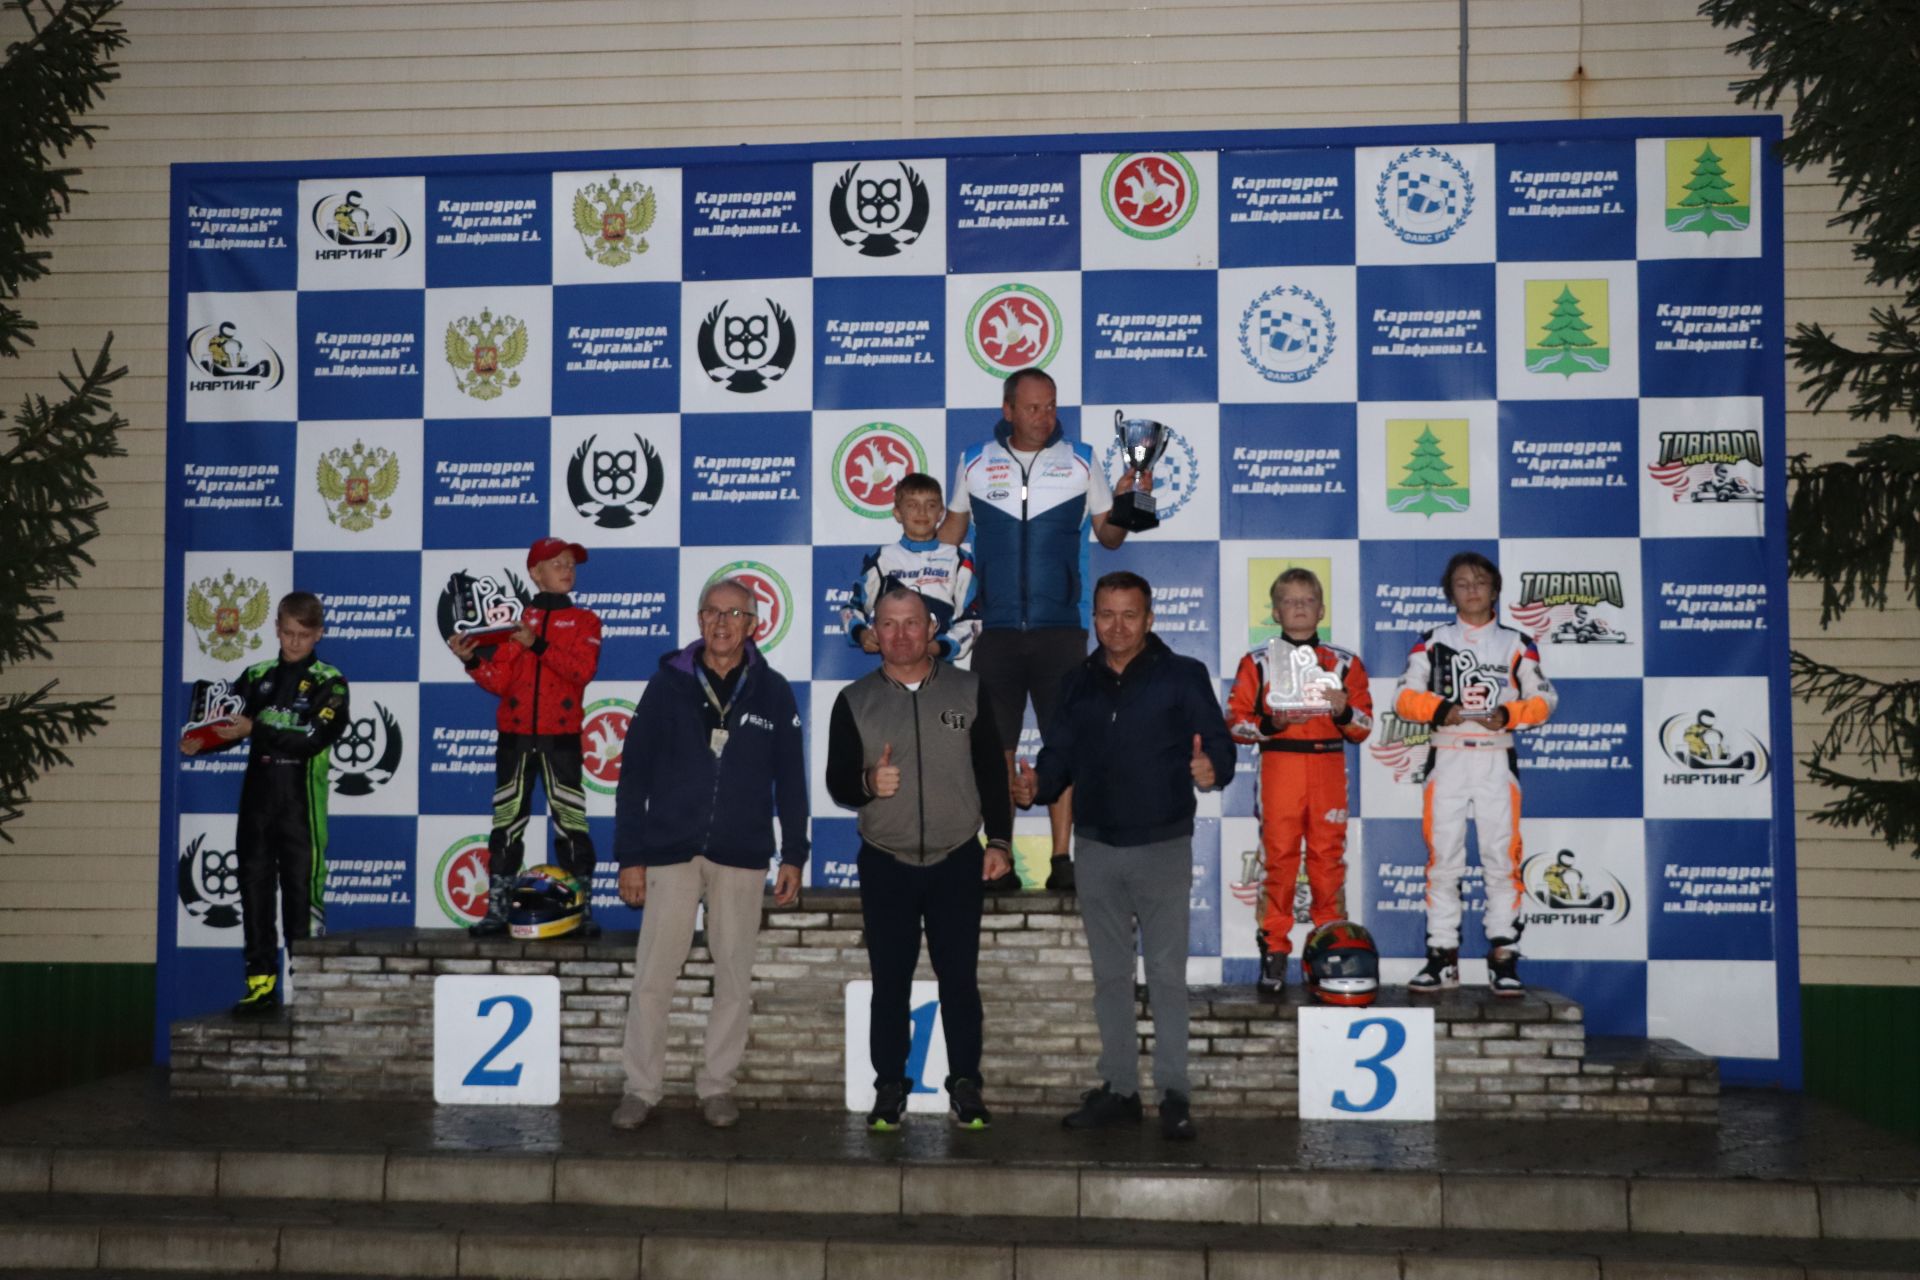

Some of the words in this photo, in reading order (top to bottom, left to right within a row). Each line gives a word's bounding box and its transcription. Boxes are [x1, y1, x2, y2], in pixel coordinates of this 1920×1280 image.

[1231, 176, 1338, 193] Картодром
[1509, 170, 1618, 187] Картодром
[694, 191, 796, 206] Картодром
[959, 182, 1064, 199] Картодром
[1236, 190, 1334, 207] "Аргамак"
[1514, 185, 1614, 202] "Аргамак"
[437, 199, 536, 214] Картодром
[964, 196, 1060, 213] "Аргамак"
[1602, 202, 1624, 213] Е.А.
[188, 206, 282, 220] Картодром
[699, 204, 792, 222] "Аргамак"
[1048, 214, 1069, 226] Е.А.
[1322, 208, 1343, 220] Е.А.
[191, 219, 278, 235] "Аргамак"
[442, 213, 532, 230] "Аргамак"
[780, 222, 801, 233] Е.А.
[267, 236, 287, 248] Е.А.
[521, 230, 541, 242] Е.А.
[1096, 313, 1202, 330] Картодром
[1373, 309, 1481, 326] Картодром
[567, 326, 667, 341] Картодром
[826, 319, 930, 335] Картодром
[1377, 324, 1477, 341] "Аргамак"
[1661, 319, 1761, 336] "Аргамак"
[315, 332, 414, 346] Картодром
[830, 334, 925, 351] "Аргамак"
[1101, 328, 1198, 344] "Аргамак"
[319, 346, 410, 362] "Аргамак"
[572, 339, 663, 356] "Аргамак"
[1186, 346, 1207, 357] Е.А.
[1465, 341, 1487, 354] Е.А.
[652, 357, 672, 369] Е.А.
[913, 351, 934, 363] Е.А.
[399, 363, 418, 375] Е.А.
[1233, 447, 1340, 464] Картодром
[1511, 440, 1622, 457] Картодром
[1659, 430, 1762, 467] TORNADO
[184, 463, 279, 478] Картодром
[435, 461, 535, 476] Картодром
[693, 455, 796, 471] Картодром
[1237, 463, 1336, 479] "Аргамак"
[1516, 456, 1617, 472] "Аргамак"
[187, 478, 275, 494] "Аргамак"
[440, 475, 531, 491] "Аргамак"
[697, 470, 791, 487] "Аргамак"
[1605, 474, 1627, 486] Е.А.
[779, 487, 800, 500] Е.А.
[1324, 481, 1345, 493] Е.А.
[264, 495, 283, 507] Е.А.
[519, 492, 539, 504] Е.А.
[1520, 571, 1624, 608] TORNADO
[1665, 598, 1766, 615] "Аргамак"
[395, 626, 414, 637] Е.А.
[649, 624, 670, 635] Е.А.
[433, 727, 499, 742] Картод
[1521, 738, 1622, 754] "Аргамак"
[1610, 756, 1631, 768] Е.А.
[1664, 864, 1774, 880] Картодром
[390, 891, 410, 903] Е.А.
[1669, 881, 1771, 897] "Аргамак"
[462, 995, 533, 1086] 2
[1330, 1017, 1407, 1112] 3
